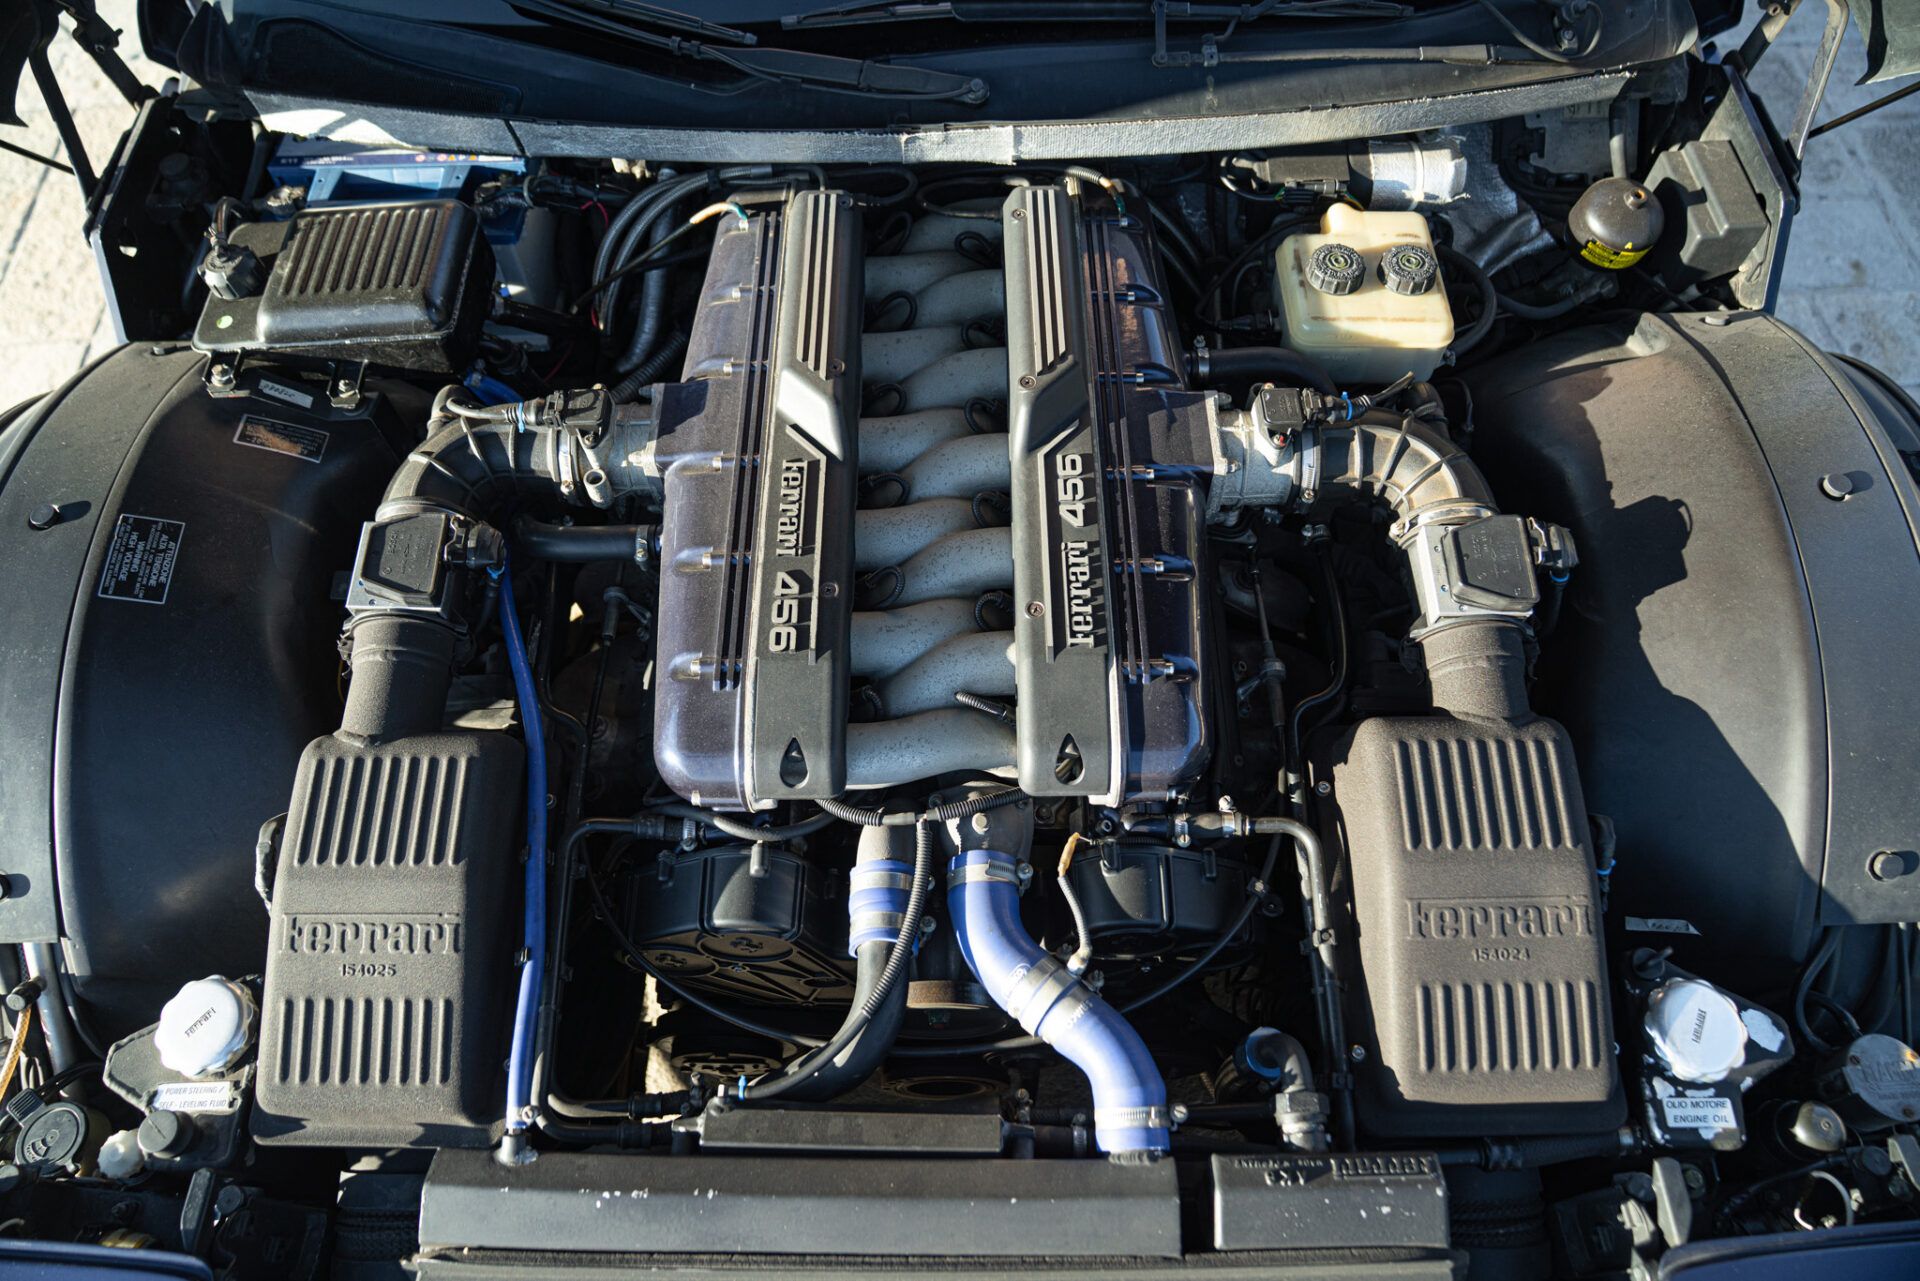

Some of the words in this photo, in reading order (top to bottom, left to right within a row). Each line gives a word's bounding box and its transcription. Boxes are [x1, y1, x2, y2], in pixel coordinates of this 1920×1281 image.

[776, 459, 807, 557] Ferrari
[1056, 454, 1085, 527] 456
[157, 533, 169, 549] ALTA
[118, 550, 133, 581] VOLTAGE
[158, 541, 176, 584] ATTENZIONE
[769, 571, 800, 653] 456
[1061, 541, 1095, 648] Ferrari
[279, 912, 461, 954] Ferrari
[1406, 895, 1594, 940] Ferrari
[340, 963, 397, 977] 154025
[1666, 1100, 1687, 1109] OLIO
[1690, 1100, 1727, 1108] MOTORE
[1673, 1115, 1709, 1123] ENGINE
